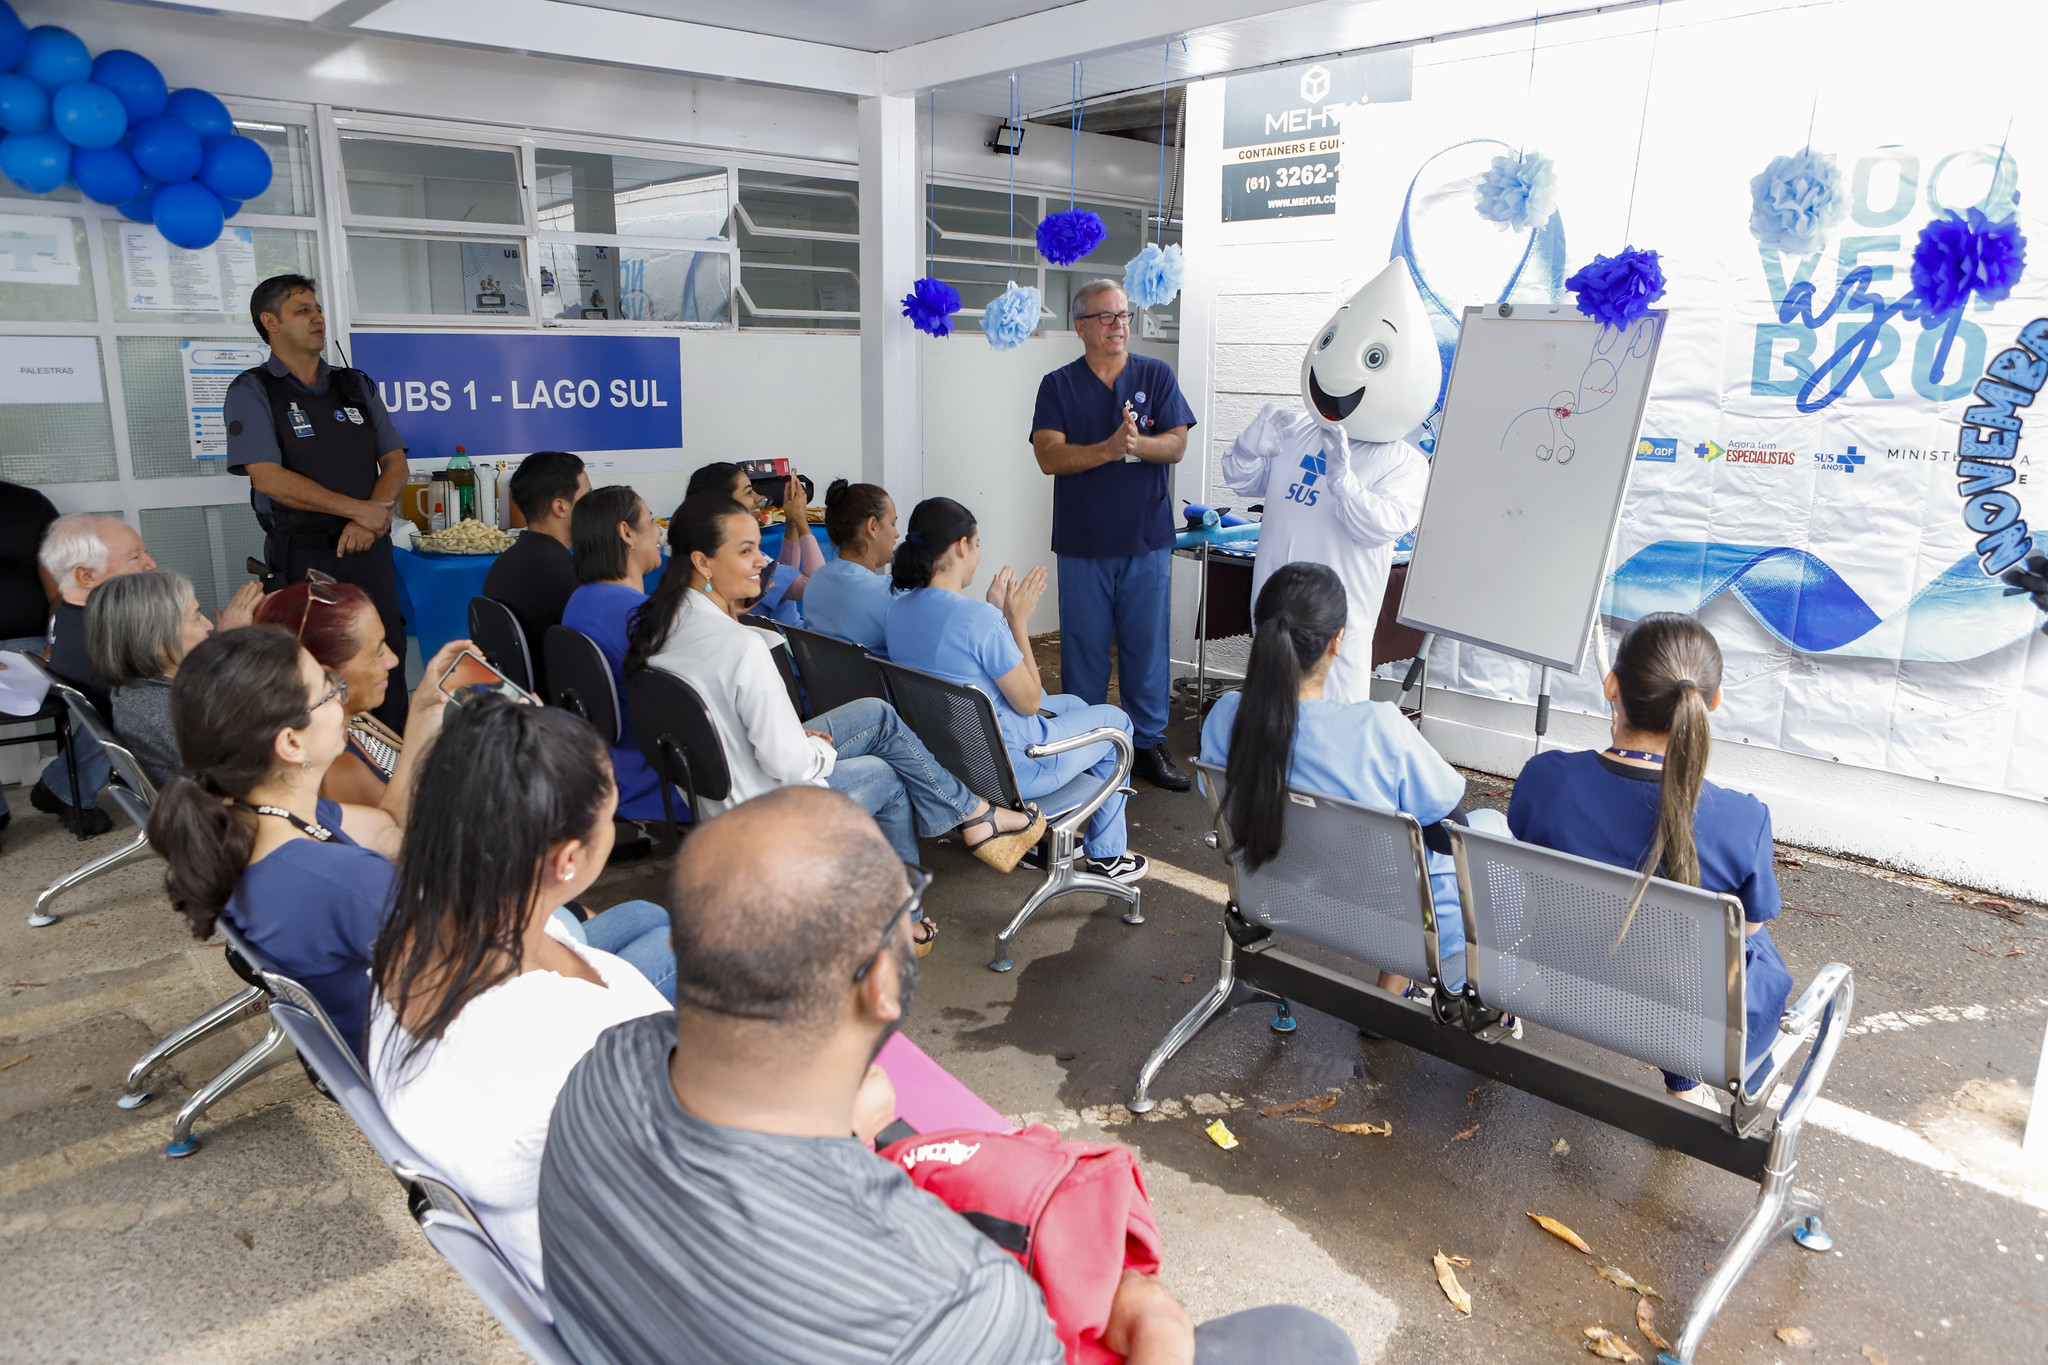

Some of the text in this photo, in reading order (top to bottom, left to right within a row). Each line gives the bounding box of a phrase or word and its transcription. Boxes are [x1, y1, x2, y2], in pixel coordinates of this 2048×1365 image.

[1238, 138, 1345, 160] CONTAINERS E GUI
[1245, 175, 1271, 193] (61)
[1267, 194, 1337, 209] WWW.MEHTA.CO
[503, 249, 520, 259] UB
[1750, 318, 1988, 402] BRO
[20, 367, 74, 376] PALESTRAS
[378, 380, 452, 413] UBS
[463, 380, 478, 411] 1
[511, 379, 601, 410] LAGO
[609, 379, 668, 408] SUL
[1727, 439, 1777, 450] Agora tem
[1653, 447, 1675, 458] GDF
[1725, 449, 1796, 466] ESPECIALISTAS
[1813, 452, 1834, 463] SUS
[1820, 463, 1843, 471] ANOS
[1285, 483, 1320, 507] SUS
